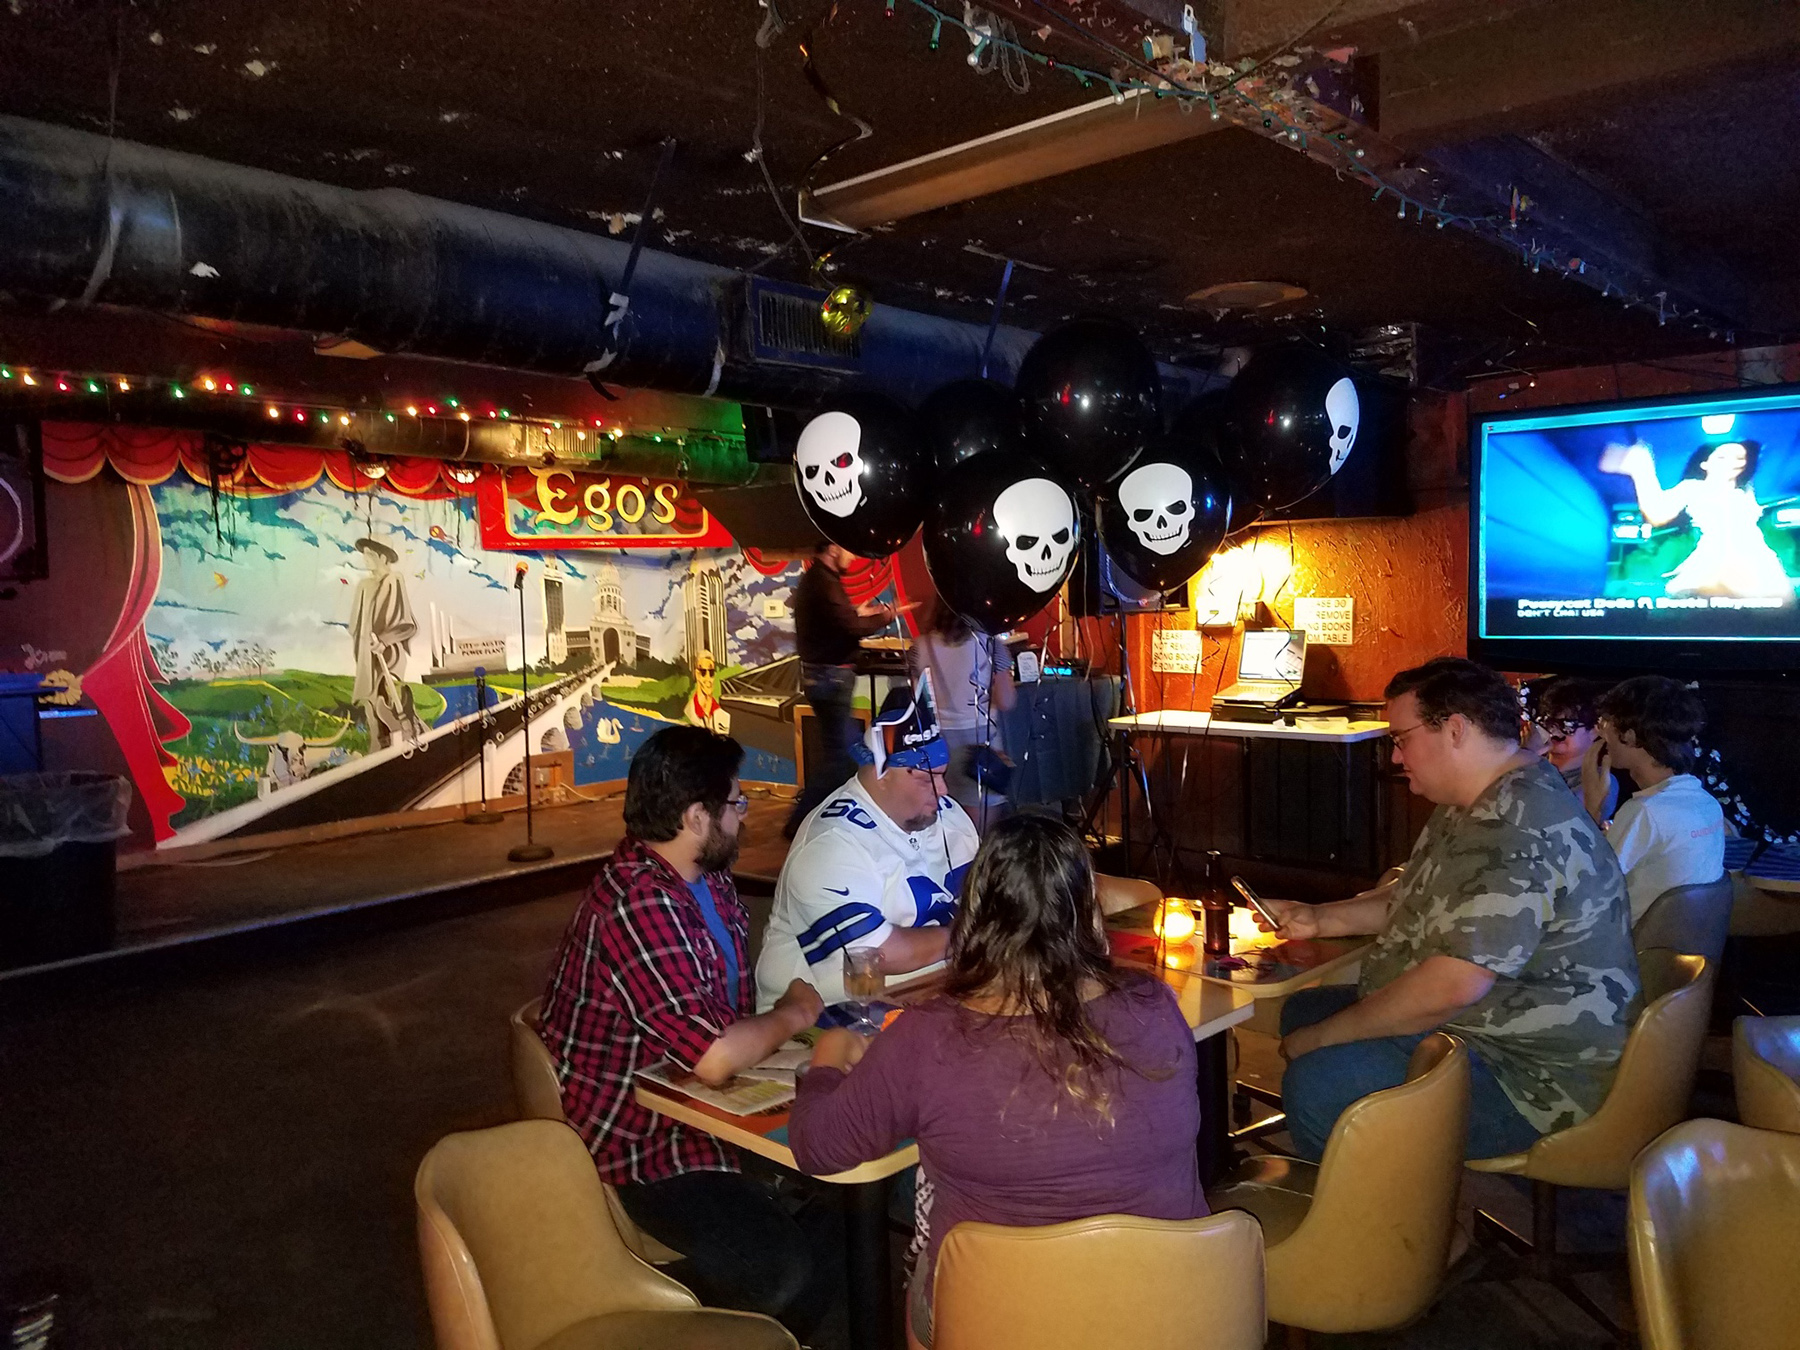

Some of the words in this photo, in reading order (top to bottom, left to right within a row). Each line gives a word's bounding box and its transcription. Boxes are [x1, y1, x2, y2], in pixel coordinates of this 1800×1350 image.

[528, 466, 679, 531] Ego's
[1315, 610, 1351, 620] REMOVE
[1321, 622, 1351, 631] BOOKS
[1175, 652, 1199, 661] BOOK
